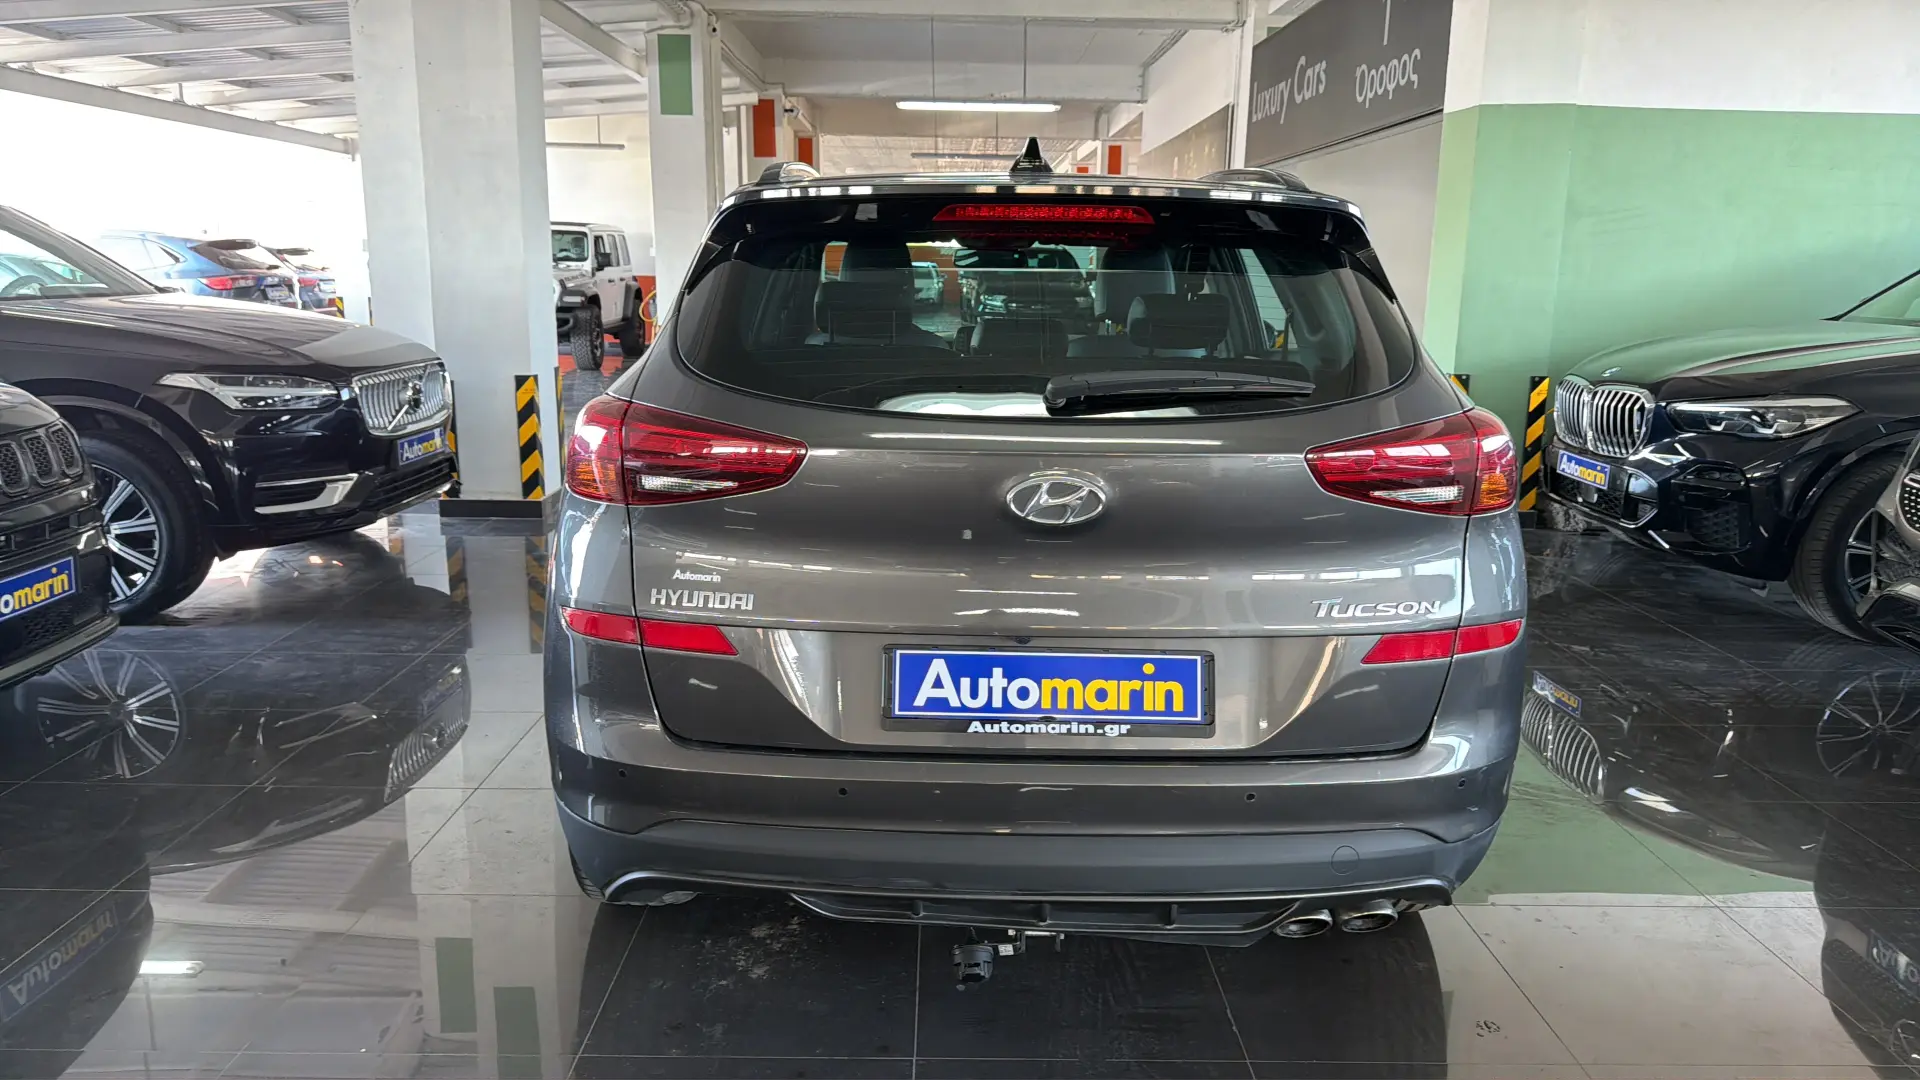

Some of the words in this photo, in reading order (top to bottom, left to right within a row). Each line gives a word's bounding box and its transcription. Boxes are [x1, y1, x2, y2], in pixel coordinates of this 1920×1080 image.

[1252, 79, 1291, 125] Luxury
[1293, 55, 1327, 104] Cars
[1559, 454, 1606, 486] Automarin
[672, 569, 721, 583] Automarin
[650, 588, 754, 611] HYUNDAI
[912, 658, 1184, 712] Automarin
[967, 721, 1131, 737] Automarin.gr
